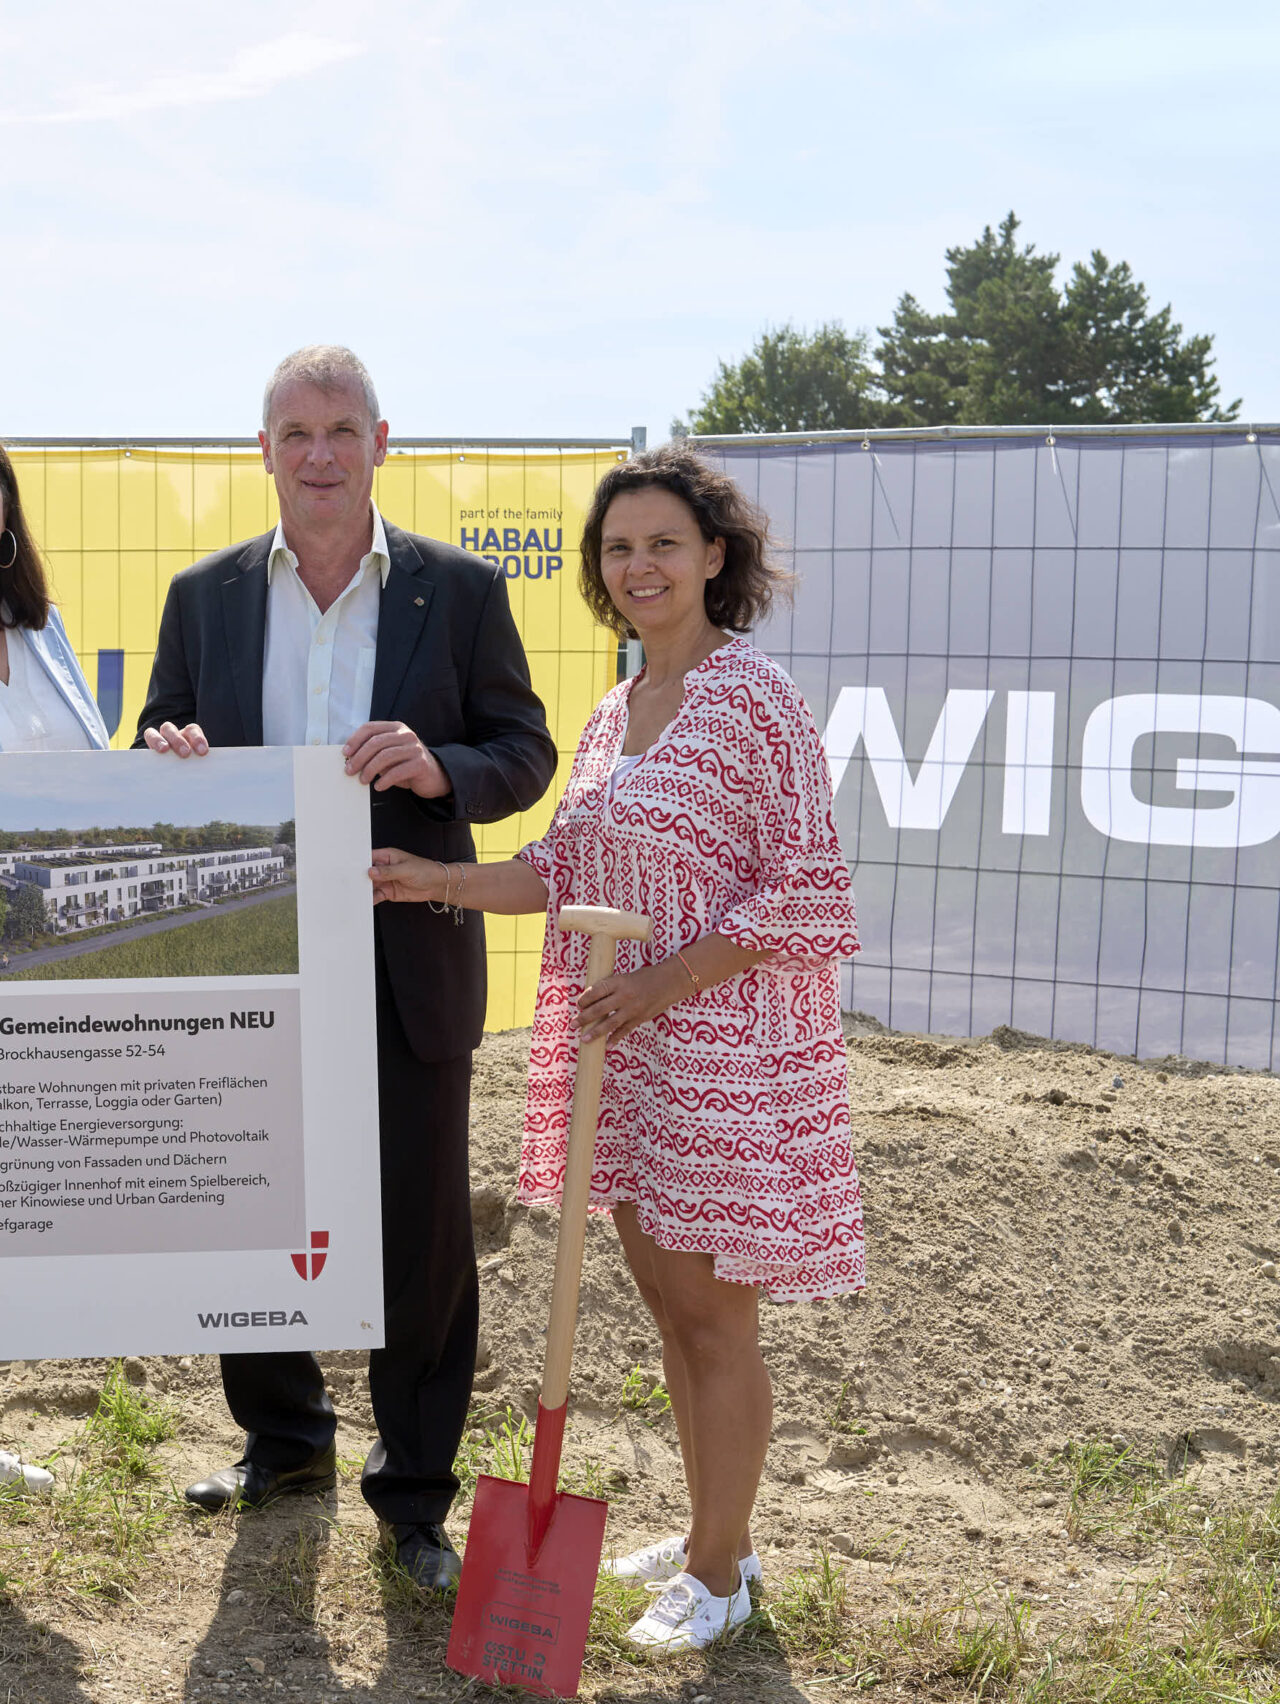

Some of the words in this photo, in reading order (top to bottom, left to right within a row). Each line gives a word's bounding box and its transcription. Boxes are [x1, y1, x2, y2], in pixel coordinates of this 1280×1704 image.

[460, 509, 485, 521] part
[488, 508, 500, 519] of
[503, 508, 522, 519] the
[526, 508, 562, 521] family
[461, 527, 562, 552] HABAU
[229, 1011, 274, 1029] NEU
[125, 1044, 165, 1057] 52-54
[37, 1081, 117, 1095] Wohnungen
[119, 1079, 141, 1091] mit
[143, 1079, 196, 1094] privaten
[198, 1076, 268, 1089] Freiflächen
[35, 1097, 92, 1110] Terrasse,
[94, 1096, 138, 1111] Loggia
[140, 1094, 171, 1107] oder
[173, 1092, 222, 1107] Garten)
[59, 1118, 183, 1134] Energieversorgung:
[161, 1131, 186, 1144] und
[189, 1129, 269, 1143] Photovoltaik
[56, 1160, 81, 1169] von
[83, 1155, 142, 1168] Fassaden
[145, 1154, 170, 1166] und
[172, 1153, 227, 1166] Dächern
[64, 1177, 122, 1190] Innenhof
[124, 1177, 145, 1189] mit
[147, 1177, 187, 1188] einem
[189, 1173, 270, 1190] Spielbereich,
[20, 1195, 85, 1207] Kinowiese
[87, 1193, 112, 1206] und
[115, 1192, 155, 1205] Urban
[157, 1191, 224, 1206] Gardening
[197, 1310, 308, 1328] WIGEBA
[489, 1614, 552, 1638] WIGEBA
[482, 1655, 544, 1682] STETTIN
